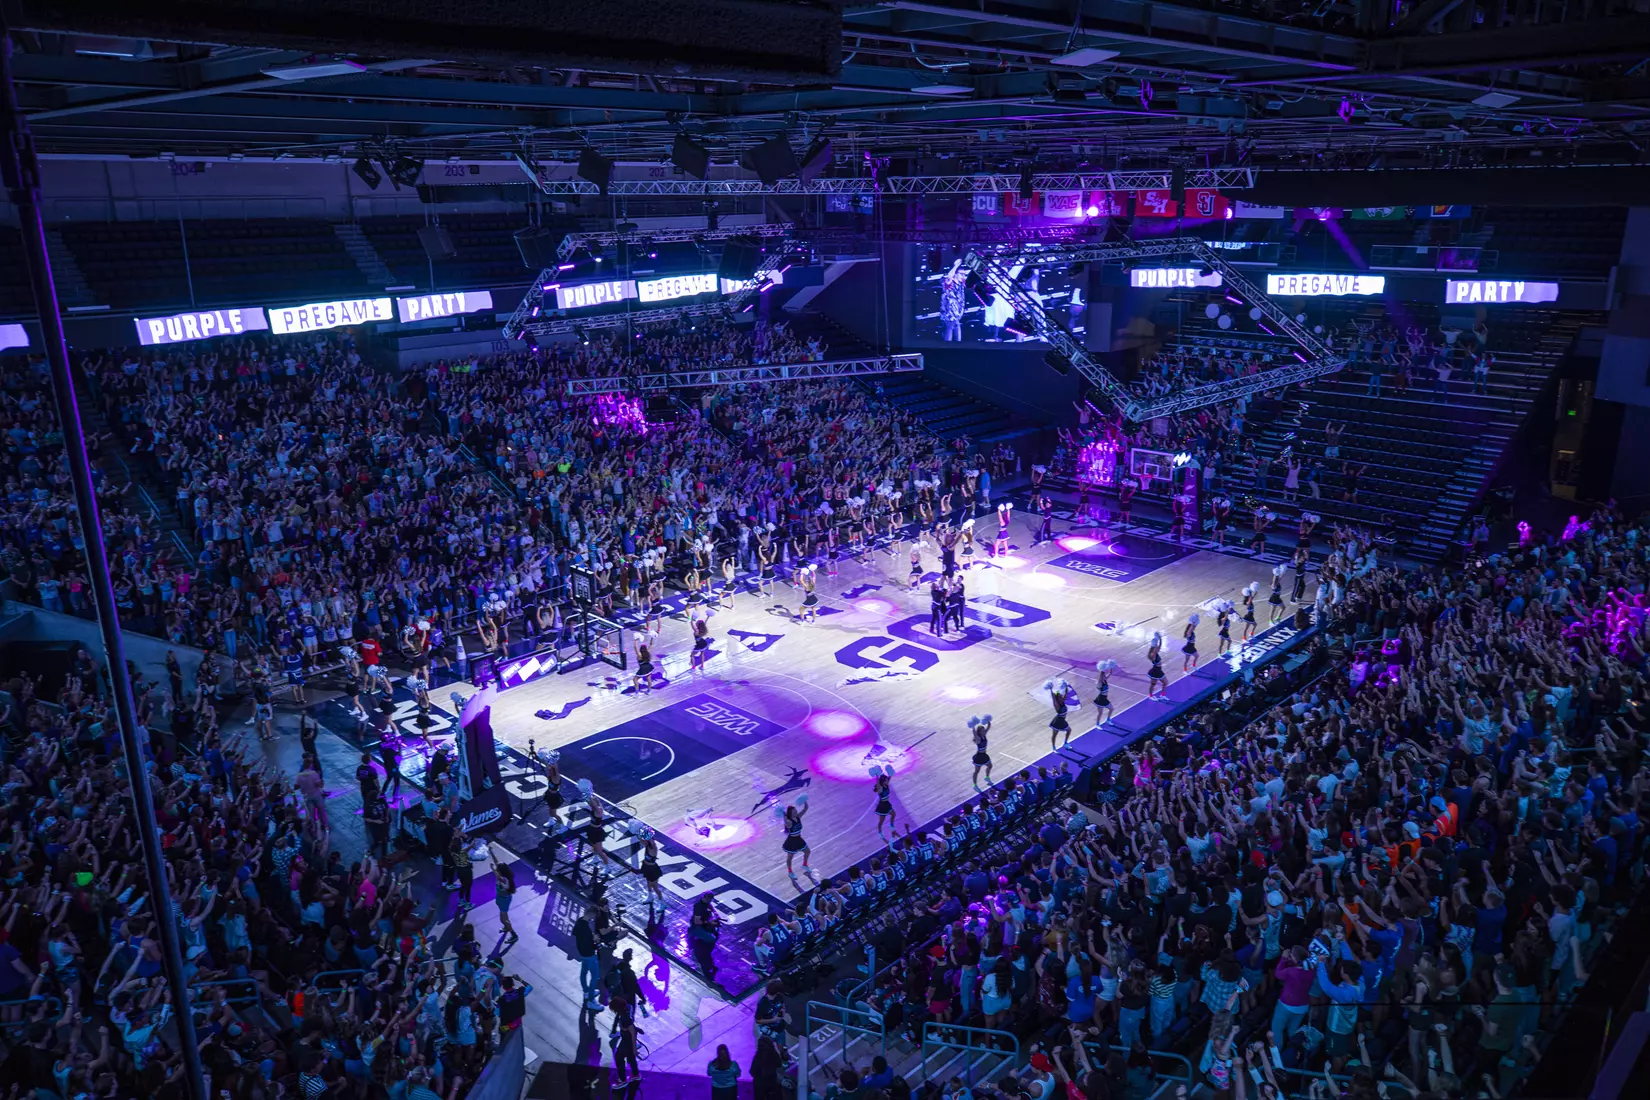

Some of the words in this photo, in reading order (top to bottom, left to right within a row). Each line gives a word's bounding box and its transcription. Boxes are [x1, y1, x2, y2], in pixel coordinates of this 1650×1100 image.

[444, 165, 465, 177] 203
[649, 167, 665, 177] 202
[1047, 194, 1081, 210] WAC
[564, 281, 622, 308] PURPLE
[648, 275, 710, 300] PREGAME
[1138, 269, 1195, 288] PURPLE
[1278, 275, 1360, 293] PREGAME
[1456, 281, 1525, 302] PARTY
[148, 309, 243, 344] PURPLE
[283, 299, 381, 331] PREGAME
[407, 292, 466, 320] PARTY
[834, 594, 1052, 673] GCU
[684, 702, 760, 736] WAC
[854, 884, 867, 897] 30
[804, 921, 815, 935] 31
[775, 930, 788, 943] 14
[812, 1026, 837, 1042] 112
